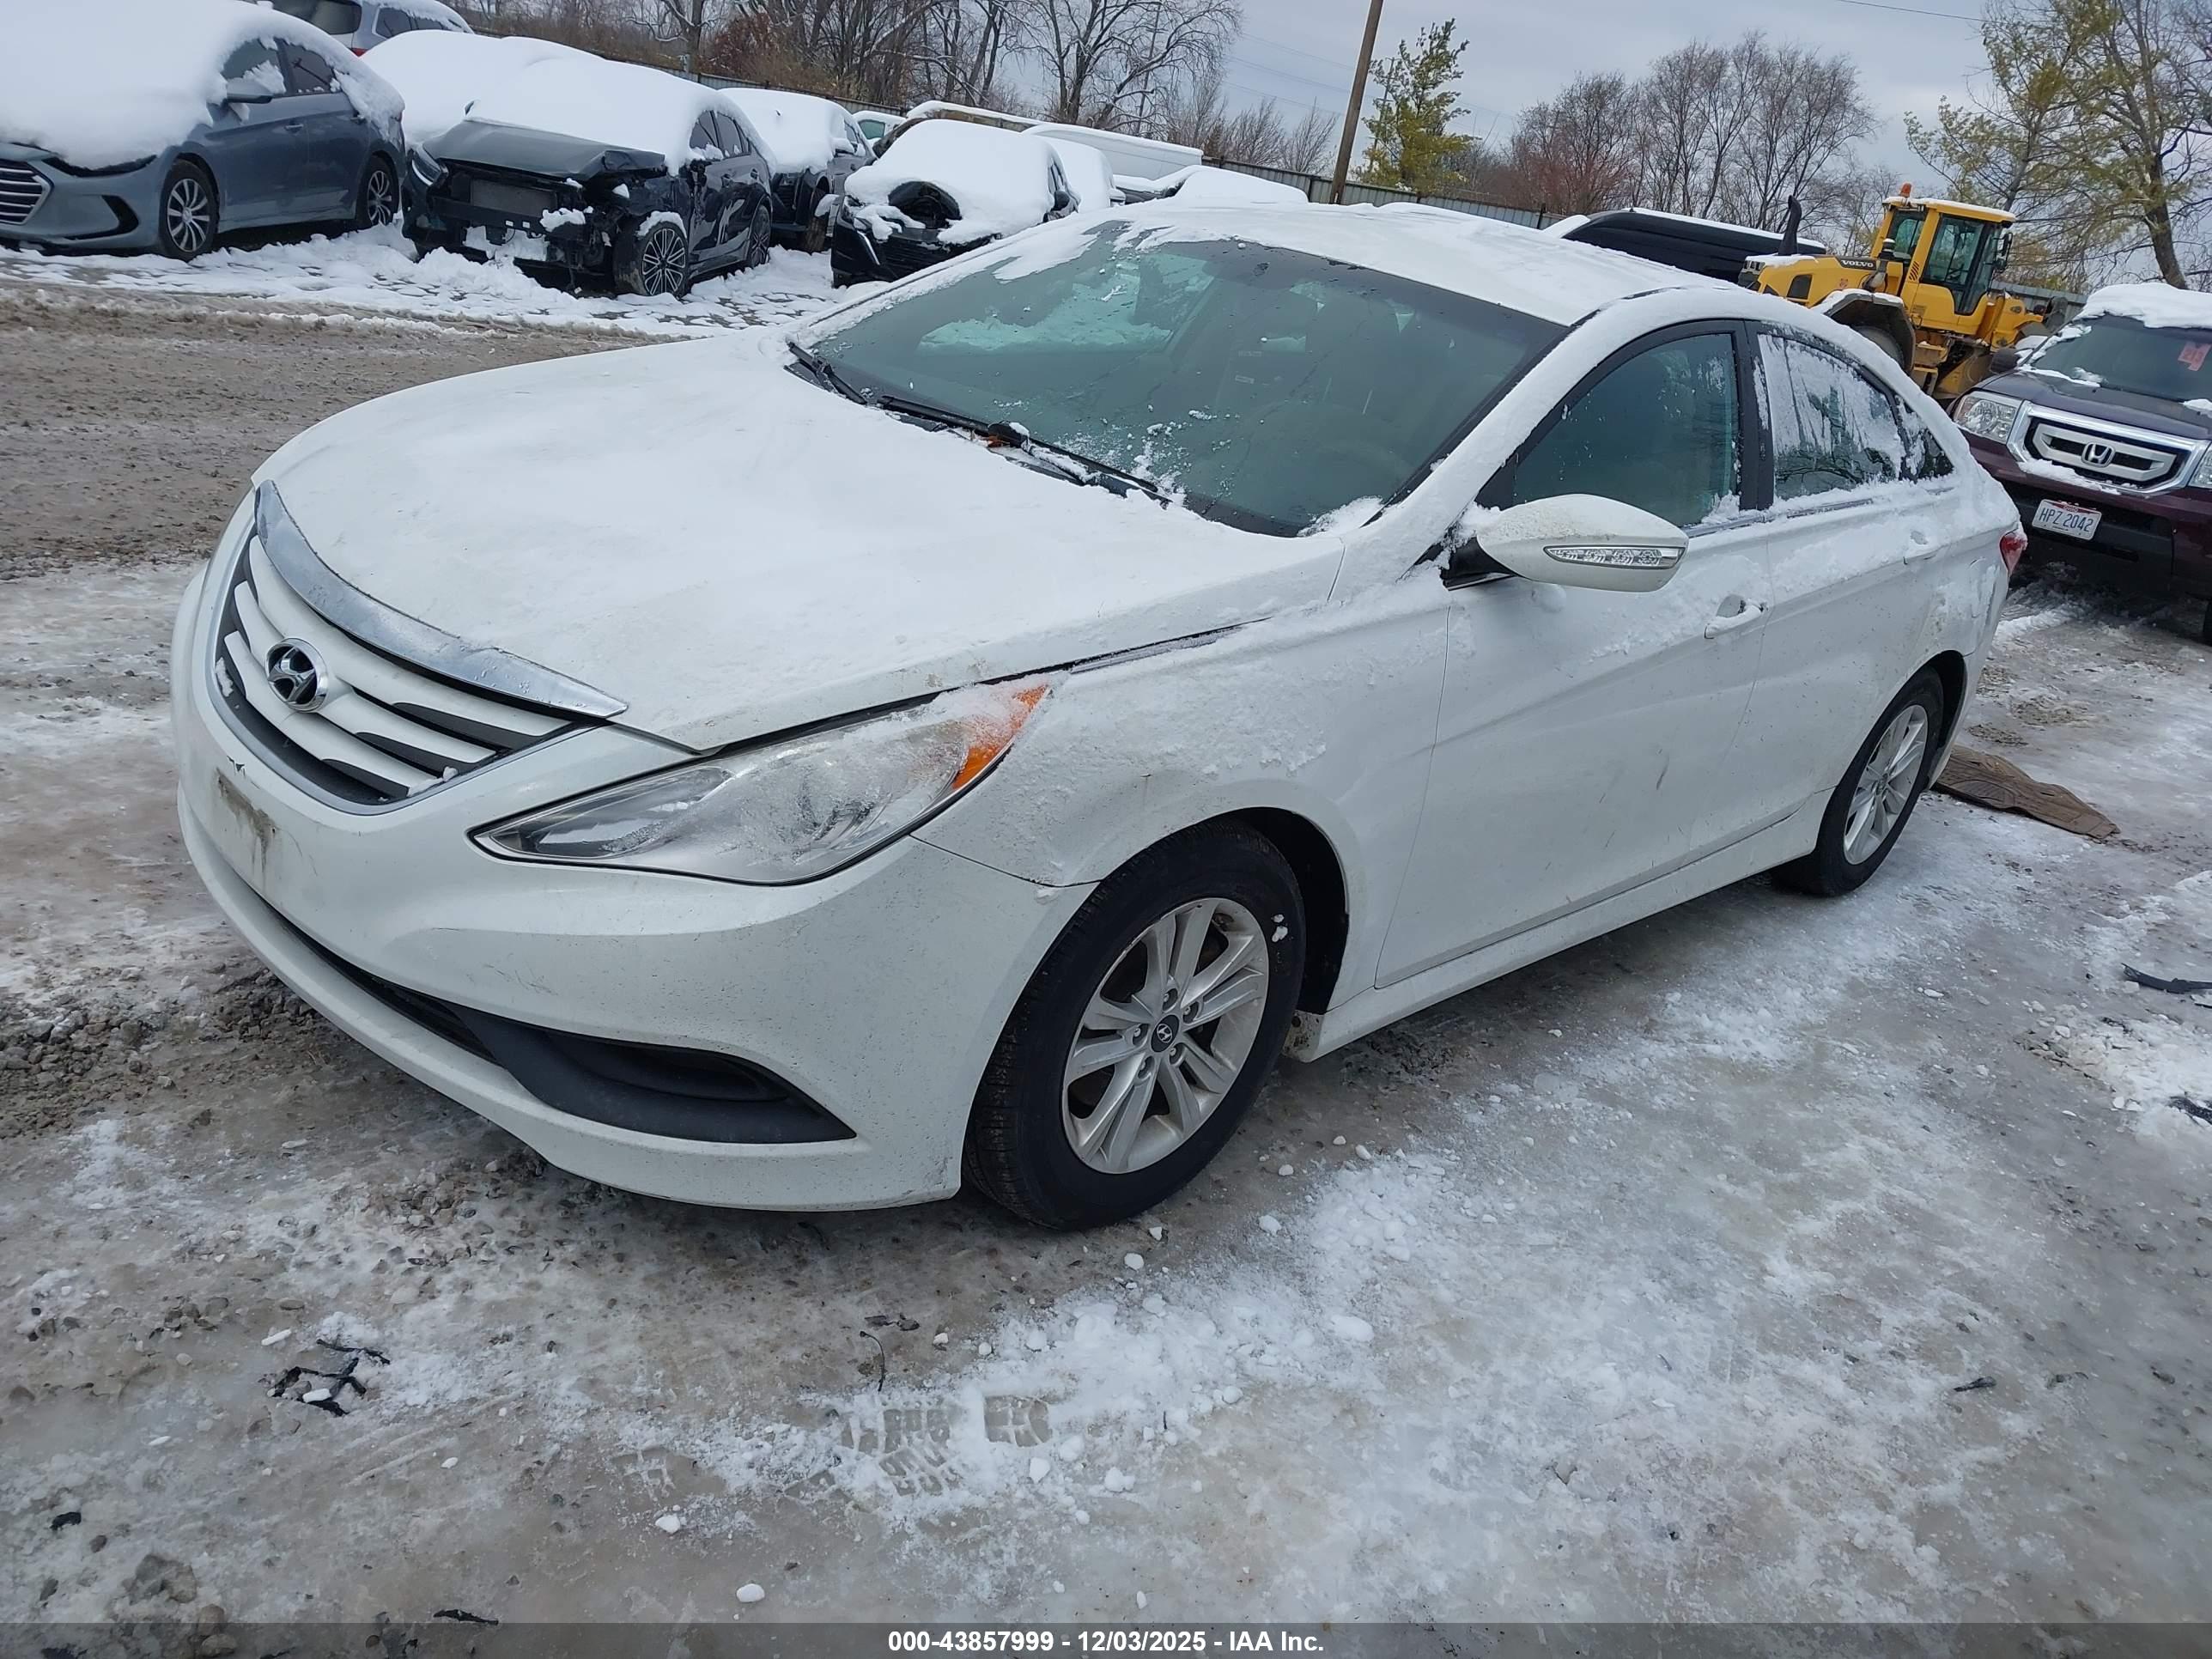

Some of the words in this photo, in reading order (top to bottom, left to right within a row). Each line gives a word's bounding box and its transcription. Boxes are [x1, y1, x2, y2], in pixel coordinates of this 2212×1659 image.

[1841, 259, 1874, 268] VOLVO
[2039, 507, 2063, 525] HPZ
[2063, 513, 2094, 532] 2042
